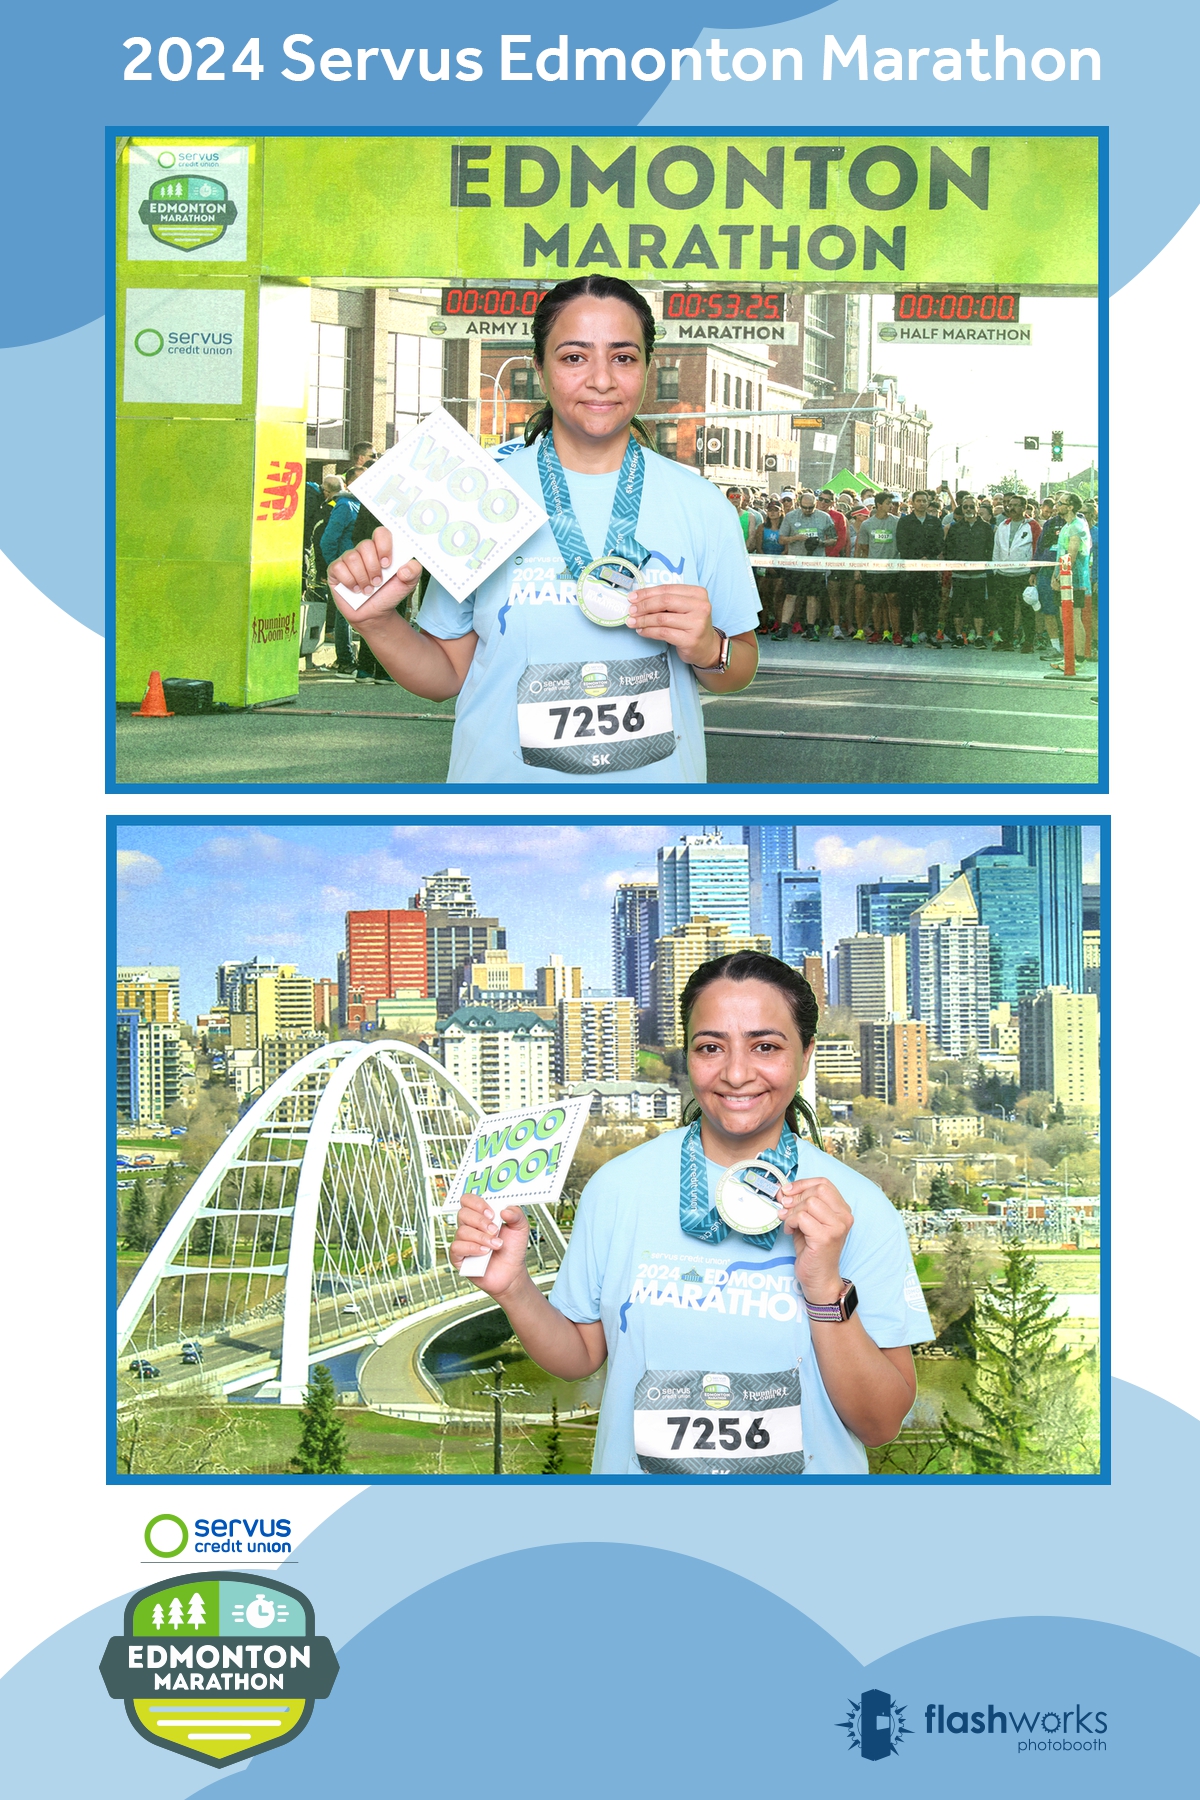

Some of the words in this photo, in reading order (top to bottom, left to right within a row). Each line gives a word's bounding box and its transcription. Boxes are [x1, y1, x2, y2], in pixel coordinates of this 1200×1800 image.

[178, 152, 219, 160] servus
[450, 144, 990, 211] EDMONTON
[149, 203, 227, 213] EDMONTON
[160, 214, 215, 222] MARATHON
[523, 223, 906, 271] MARATHON
[466, 321, 517, 335] ARMY
[679, 325, 785, 340] MARATHON
[900, 328, 939, 340] HALF
[943, 329, 1030, 341] MARATHON
[168, 332, 233, 345] servus
[168, 345, 200, 355] credit
[203, 347, 232, 355] union
[409, 435, 519, 524] WOO
[549, 472, 559, 495] credit
[555, 496, 563, 516] union
[626, 484, 634, 494] 5K
[372, 474, 498, 570] HOO!
[524, 556, 552, 564] servus
[512, 567, 556, 581] 2024
[257, 613, 290, 641] Running
[544, 679, 570, 688] servus
[625, 671, 654, 685] Running
[549, 700, 645, 740] 7256
[592, 754, 611, 766] 5K
[475, 1107, 566, 1163] WOO
[462, 1142, 562, 1197] HOO!
[690, 1163, 698, 1189] credit
[690, 1189, 698, 1212] union
[651, 1252, 678, 1262] servus
[679, 1253, 704, 1264] credit
[636, 1264, 681, 1281] 2024
[662, 1387, 690, 1395] servus
[749, 1388, 782, 1401] Running
[667, 1416, 770, 1451] 7256
